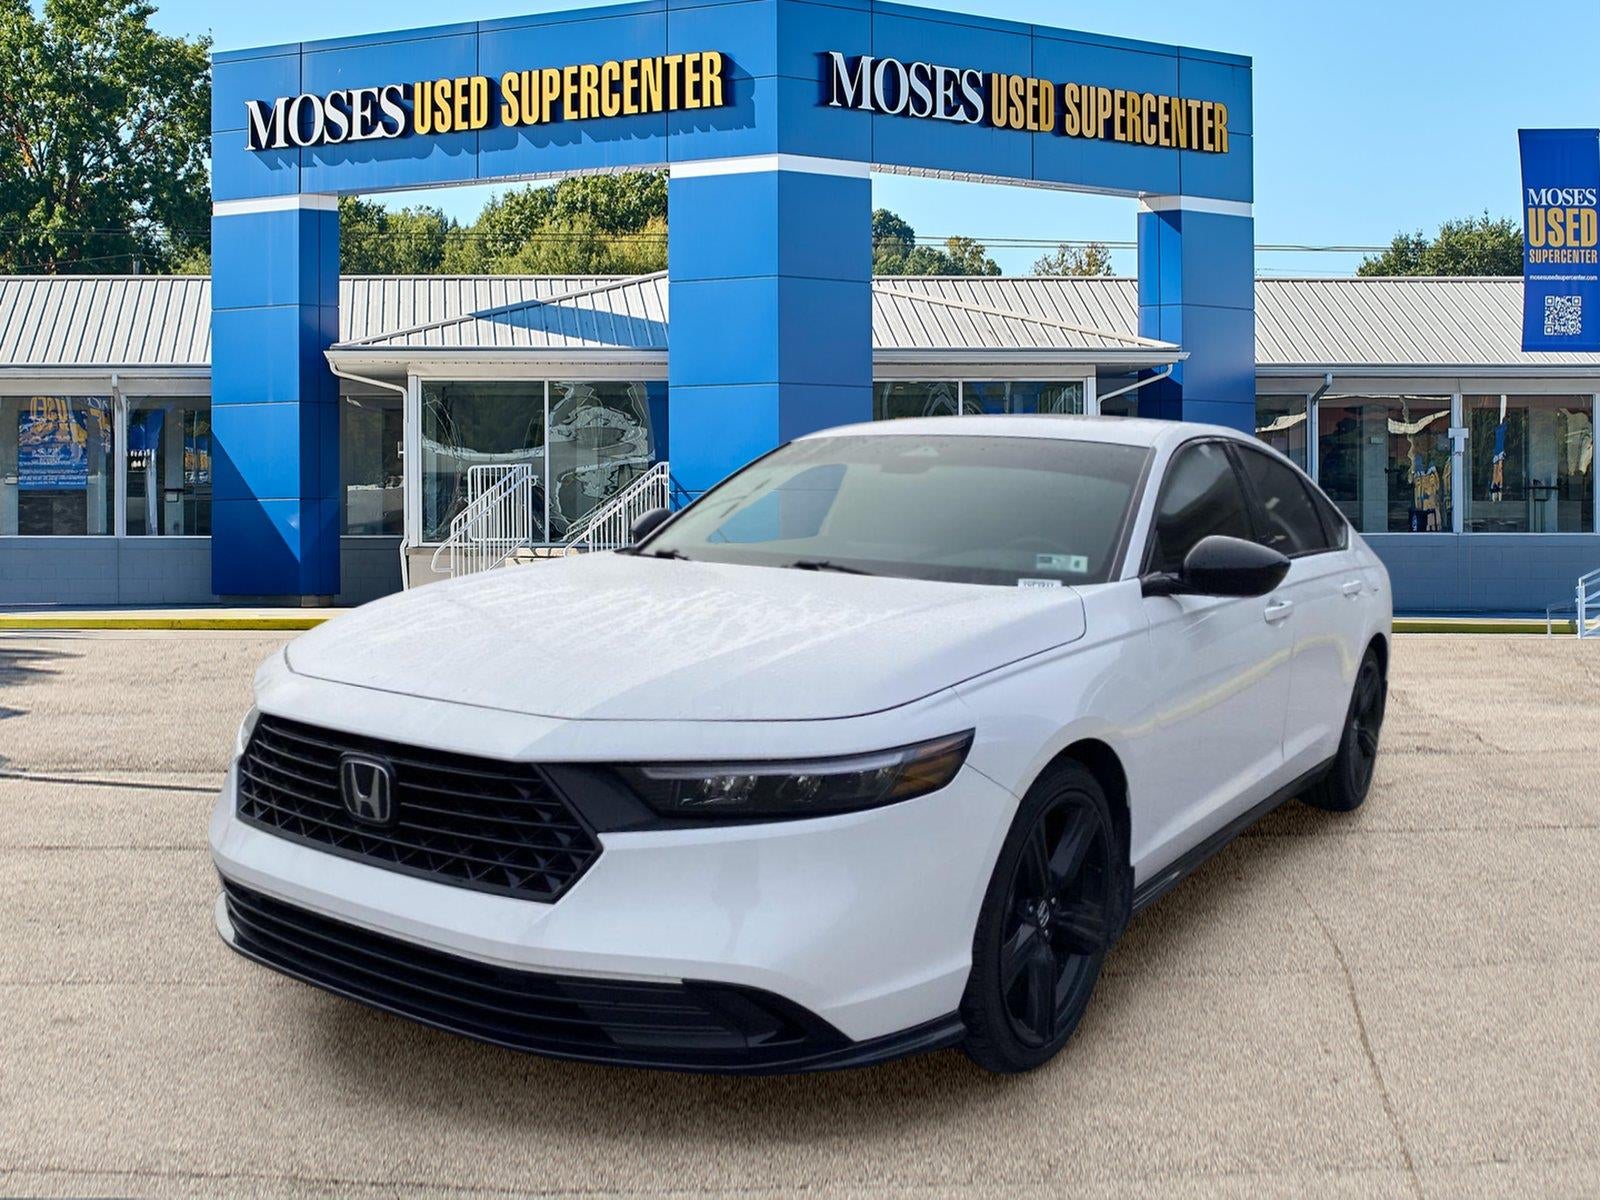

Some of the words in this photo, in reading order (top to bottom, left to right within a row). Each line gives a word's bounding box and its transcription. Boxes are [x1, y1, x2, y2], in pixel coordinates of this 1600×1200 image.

[244, 84, 406, 150] MOSES
[413, 75, 488, 135] USED
[501, 50, 723, 127] SUPERCENTER
[829, 51, 984, 124] MOSES
[991, 73, 1055, 132] USED
[1064, 82, 1229, 153] SUPERCENTER
[1527, 188, 1597, 206] MOSES
[1528, 208, 1598, 247] USED
[1529, 249, 1598, 264] SUPERCENTER
